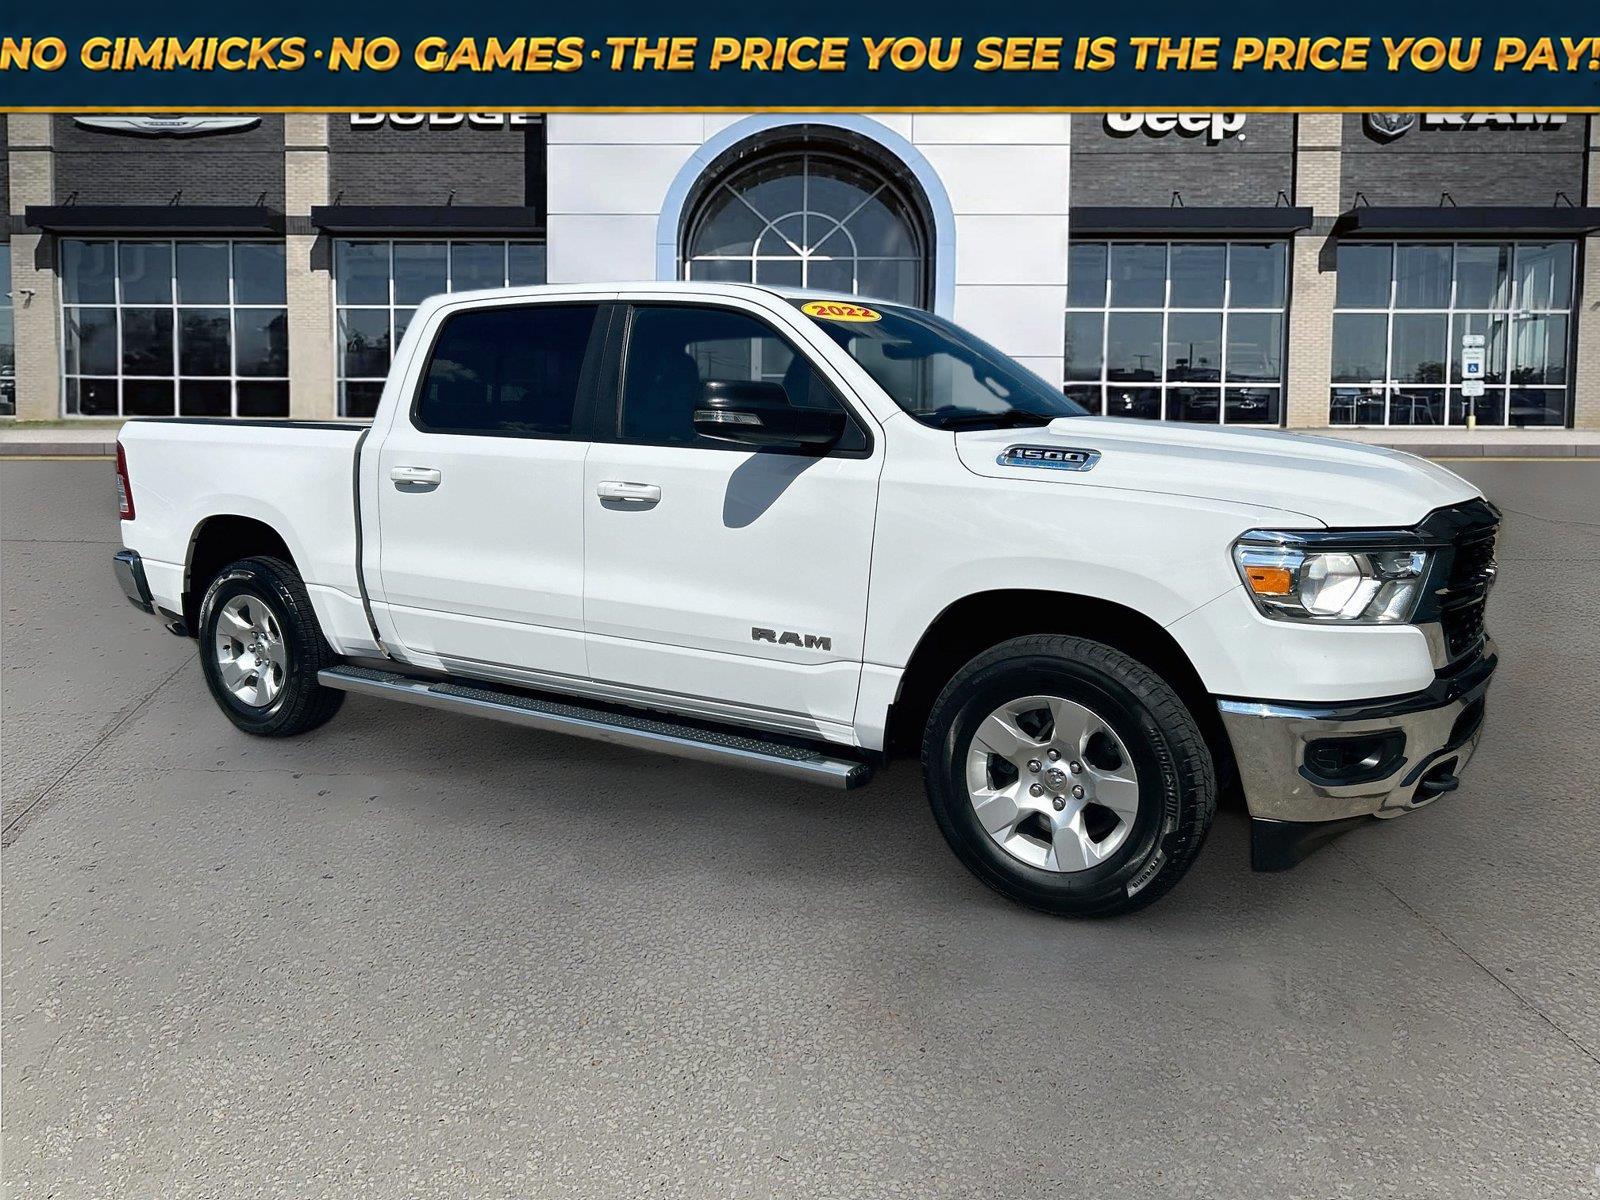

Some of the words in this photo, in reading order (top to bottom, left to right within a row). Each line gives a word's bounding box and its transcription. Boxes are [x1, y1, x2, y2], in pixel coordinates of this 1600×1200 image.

[811, 305, 875, 318] 2022
[1010, 448, 1086, 463] 1500
[751, 626, 832, 652] RAM
